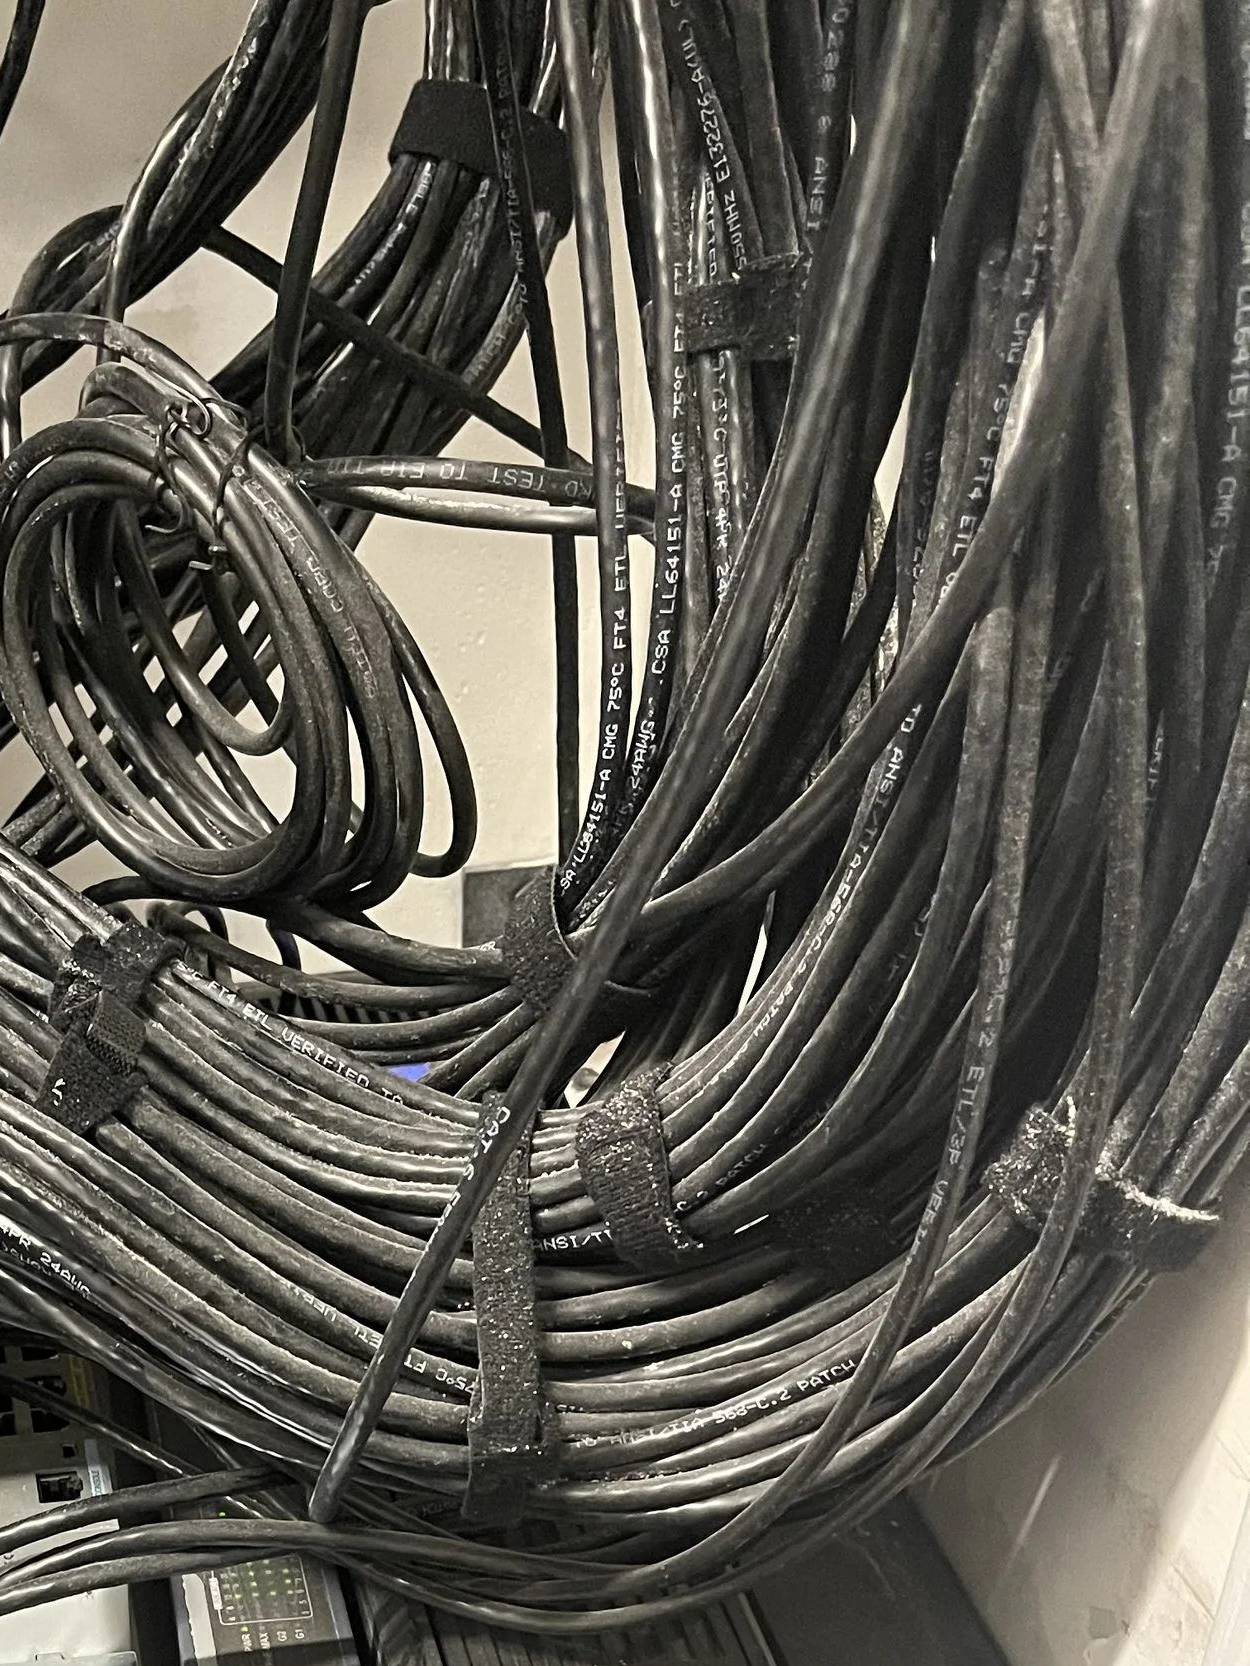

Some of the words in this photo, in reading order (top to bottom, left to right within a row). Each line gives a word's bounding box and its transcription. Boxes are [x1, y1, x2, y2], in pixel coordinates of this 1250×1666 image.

[601, 722, 620, 760] CMG
[206, 980, 237, 1005] FT4
[242, 1002, 274, 1033] ETL
[796, 1359, 858, 1392] PATCH
